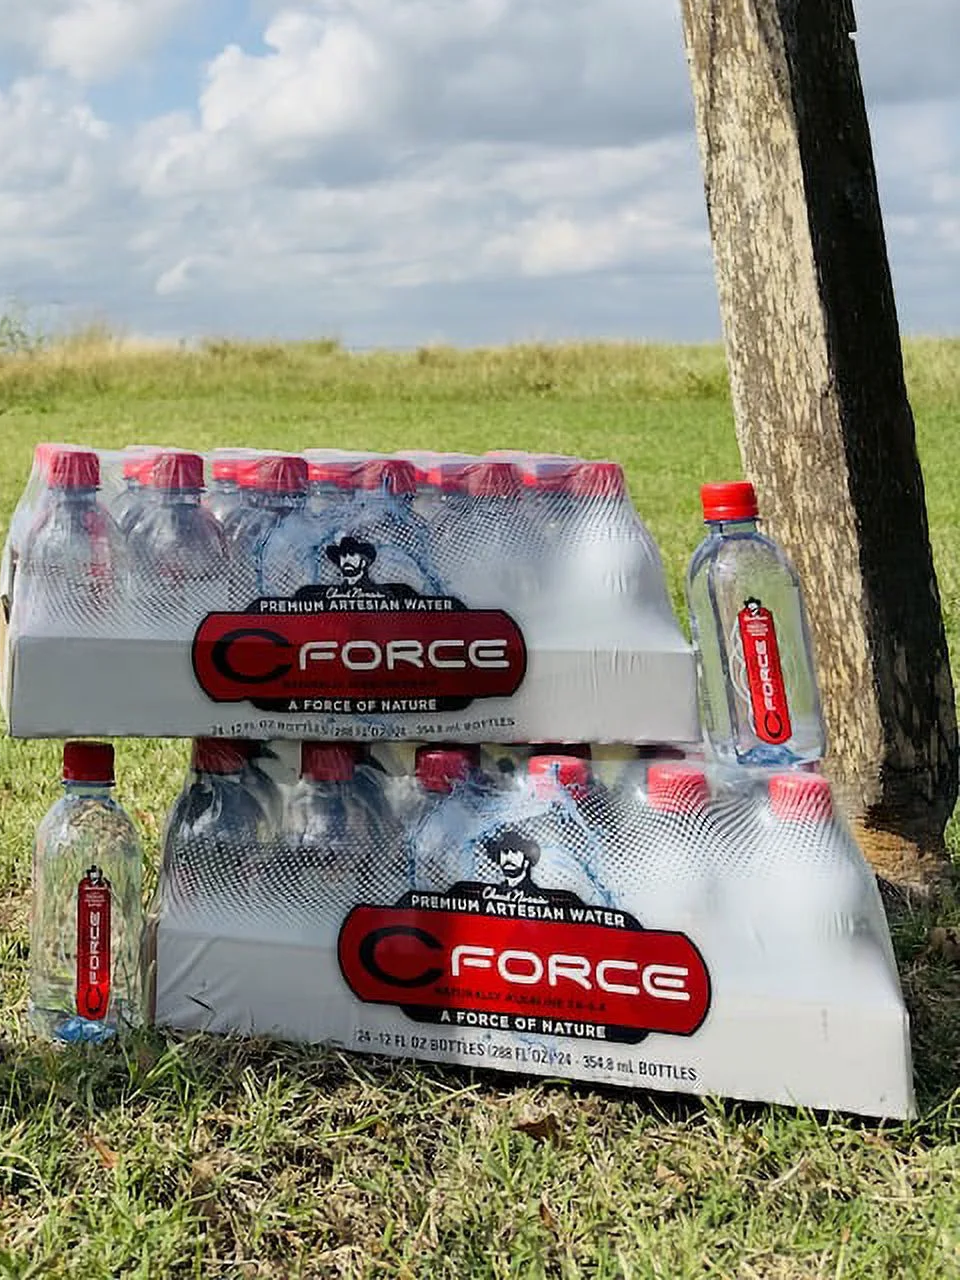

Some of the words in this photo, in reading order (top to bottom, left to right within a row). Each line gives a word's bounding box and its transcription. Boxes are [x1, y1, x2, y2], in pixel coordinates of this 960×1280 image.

[259, 600, 324, 613] PREMIUM
[328, 599, 400, 612] ARTESIAN
[403, 599, 453, 611] WATER
[288, 700, 298, 711] A
[303, 699, 352, 712] FORCE
[356, 700, 377, 712] OF
[381, 698, 437, 711] NATURE
[411, 894, 480, 913] PREMIUM
[486, 900, 565, 921] ARTESIAN
[569, 910, 626, 928] WATER
[440, 1009, 451, 1023] A
[456, 1011, 510, 1029] FORCE
[514, 1017, 537, 1031] OF
[542, 1020, 607, 1039] NATURE
[395, 1034, 406, 1048] FL
[411, 1036, 427, 1050] OZ
[430, 1038, 485, 1057] BOTTLES
[638, 1060, 699, 1081] BOTTLES
